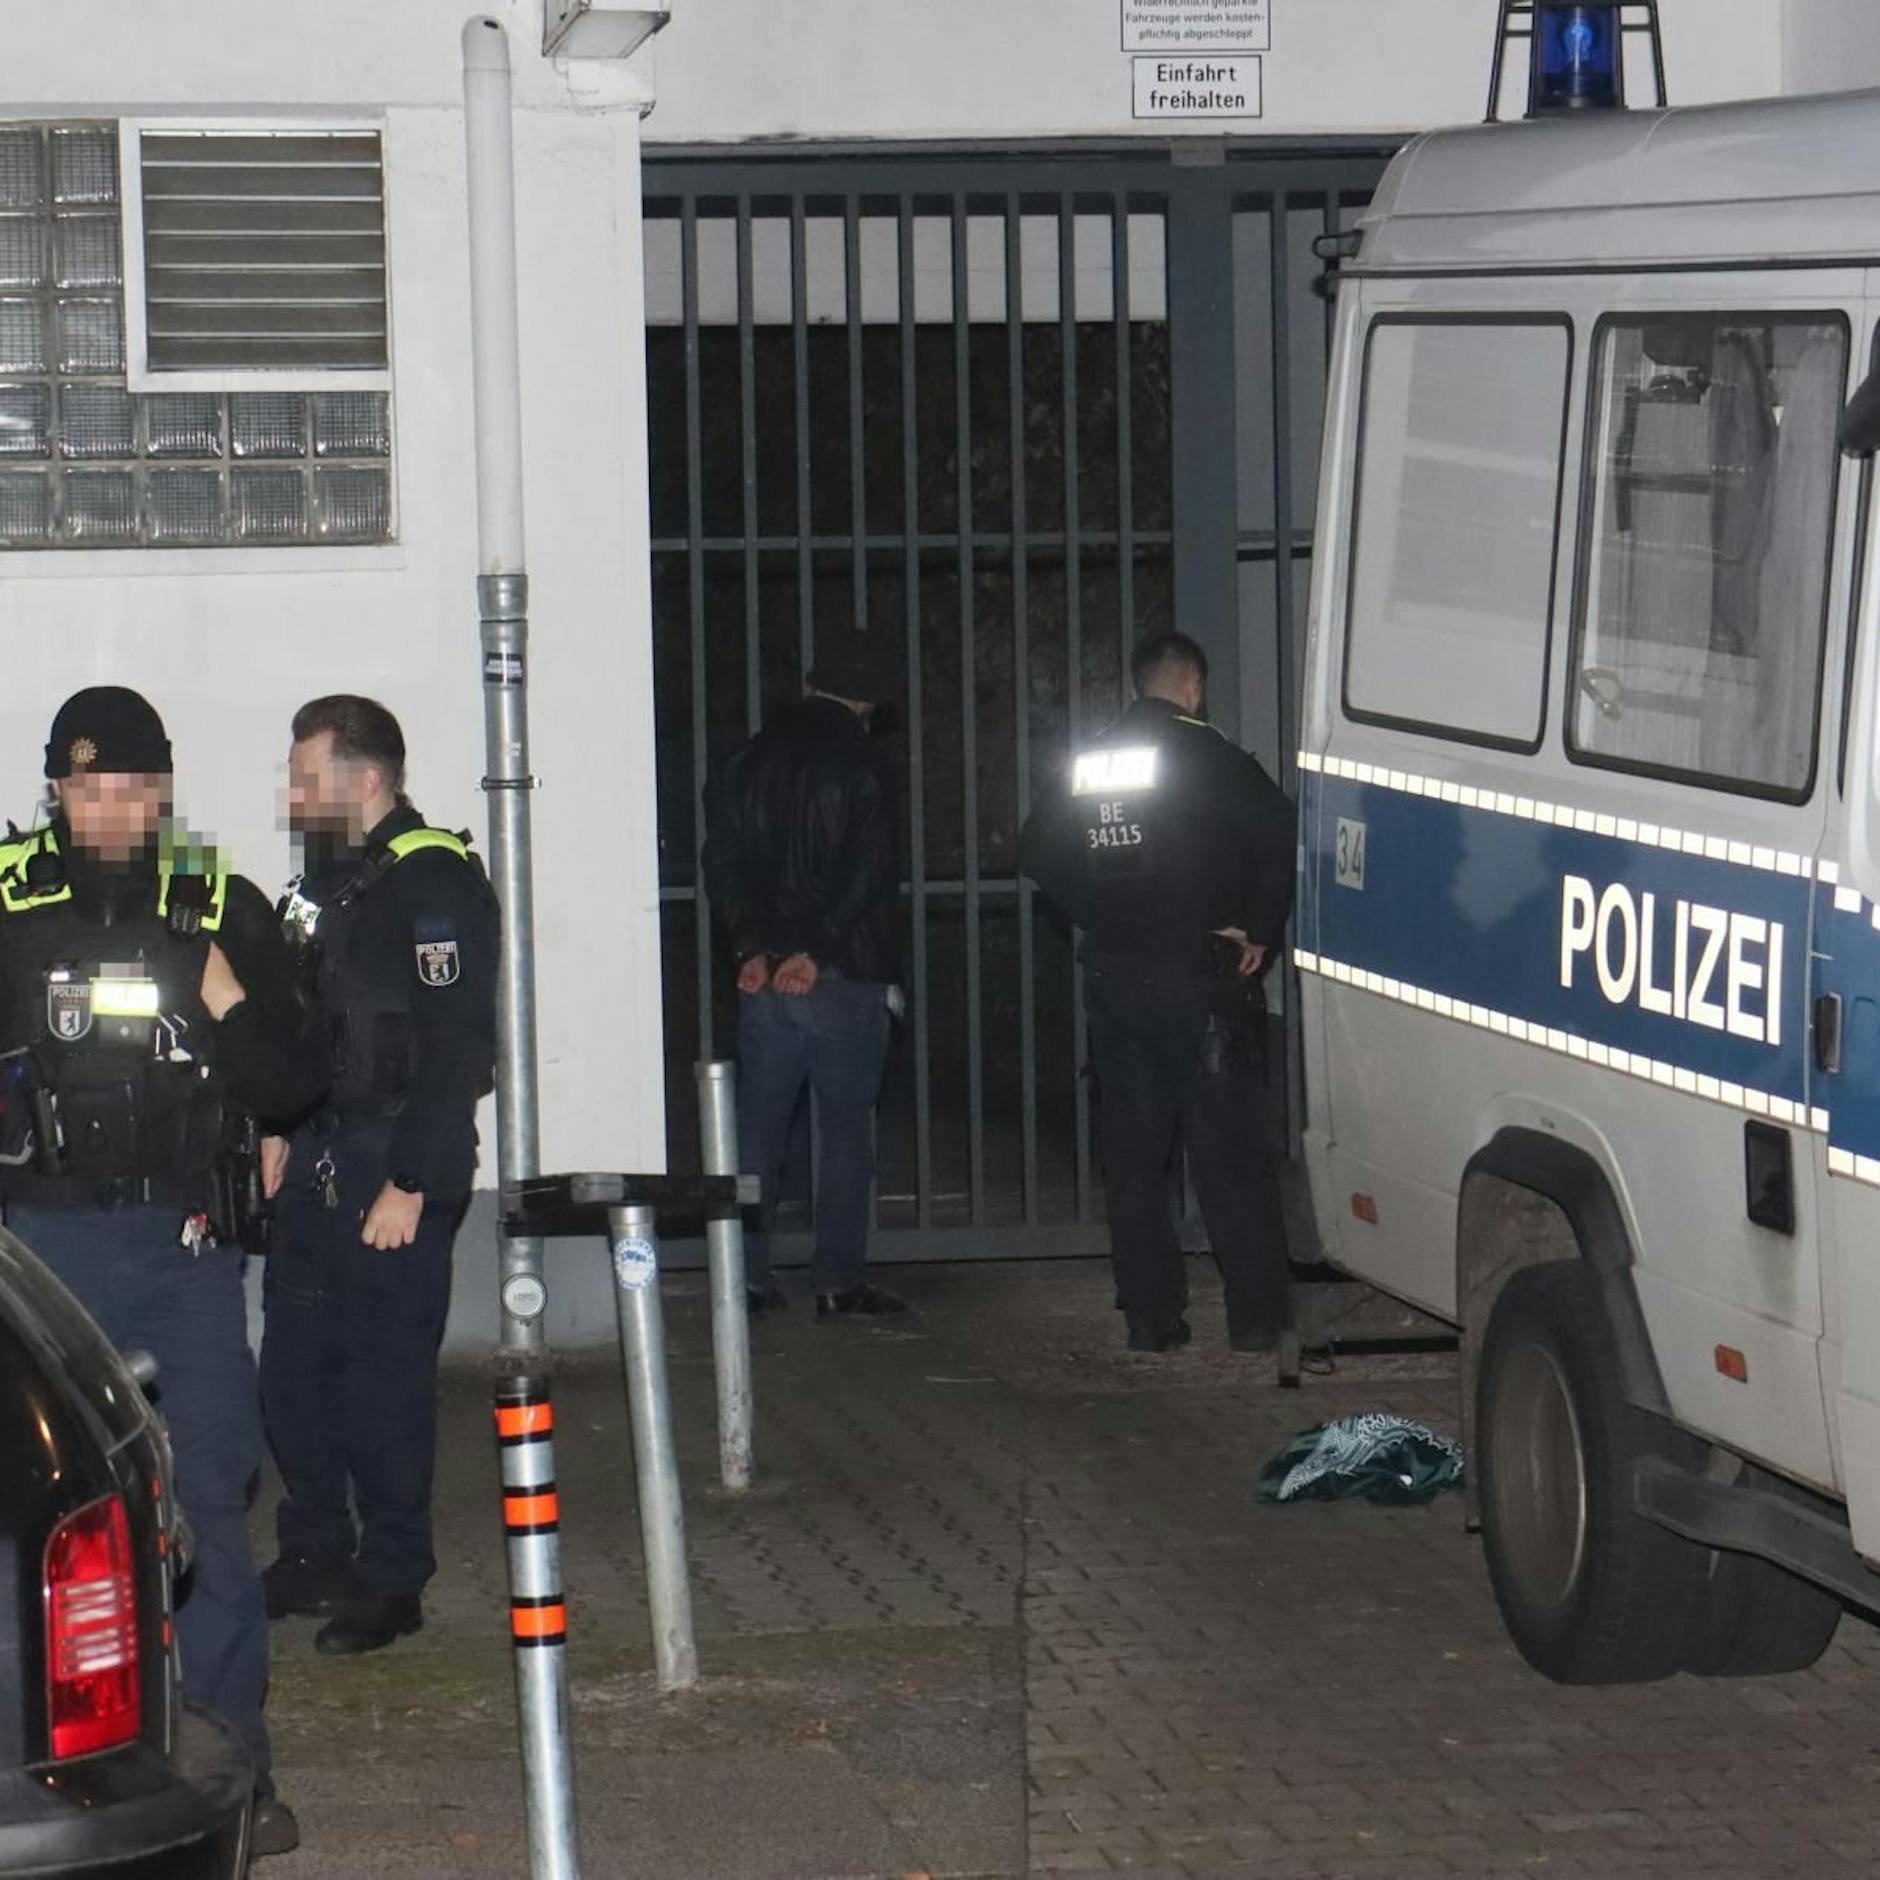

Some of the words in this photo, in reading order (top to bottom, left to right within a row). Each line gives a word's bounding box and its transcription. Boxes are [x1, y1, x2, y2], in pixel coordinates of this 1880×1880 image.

[1125, 12, 1181, 25] Fahrzeuge
[1184, 12, 1223, 23] werden
[1226, 13, 1266, 23] kosten-
[1139, 28, 1181, 40] pflichtig
[1183, 28, 1254, 41] abgeschleppt
[1157, 63, 1237, 82] Einfahrt
[1150, 90, 1246, 109] freihalten
[1100, 802, 1124, 823] BE
[1087, 825, 1142, 848] 34115
[1339, 824, 1361, 881] 34
[1560, 874, 1784, 1046] POLIZEI
[52, 986, 90, 998] POLIZEI
